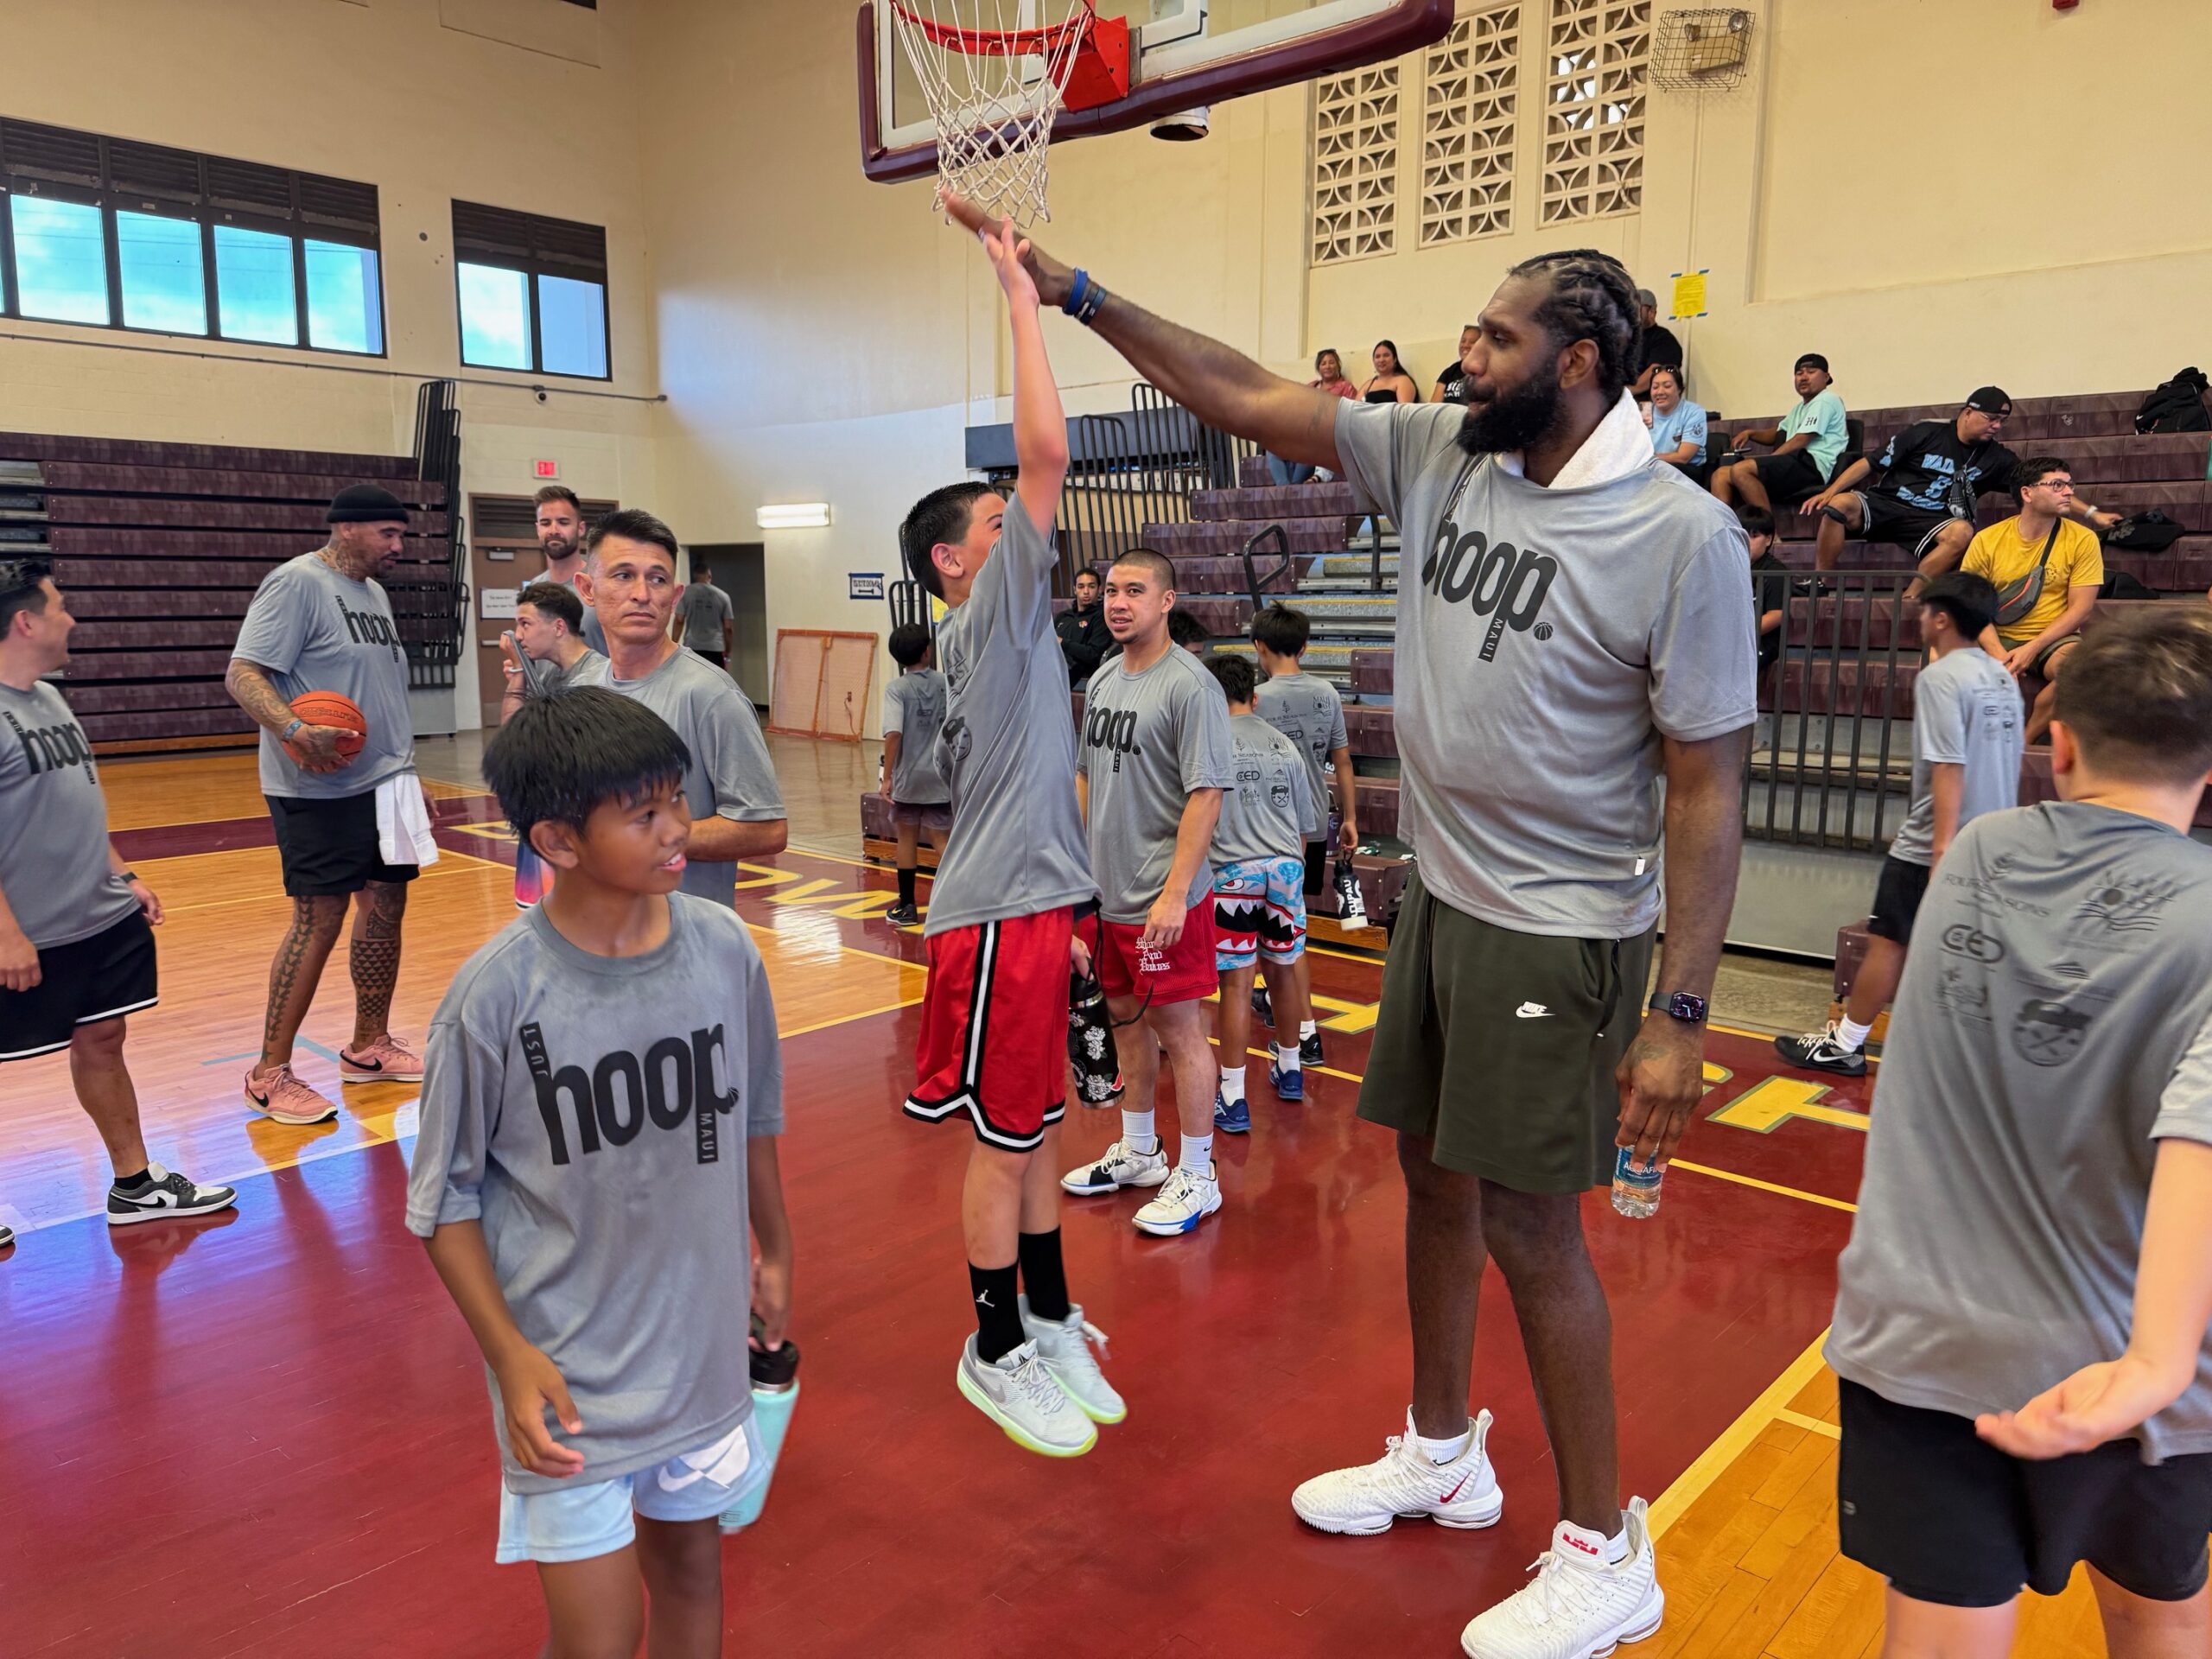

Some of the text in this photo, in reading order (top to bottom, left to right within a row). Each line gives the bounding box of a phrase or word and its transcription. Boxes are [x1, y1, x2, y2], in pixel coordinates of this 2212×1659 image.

[1480, 618, 1504, 659] MAUI
[1143, 948, 1163, 960] And
[522, 1027, 550, 1077] JUST
[699, 1112, 716, 1160] MAUI
